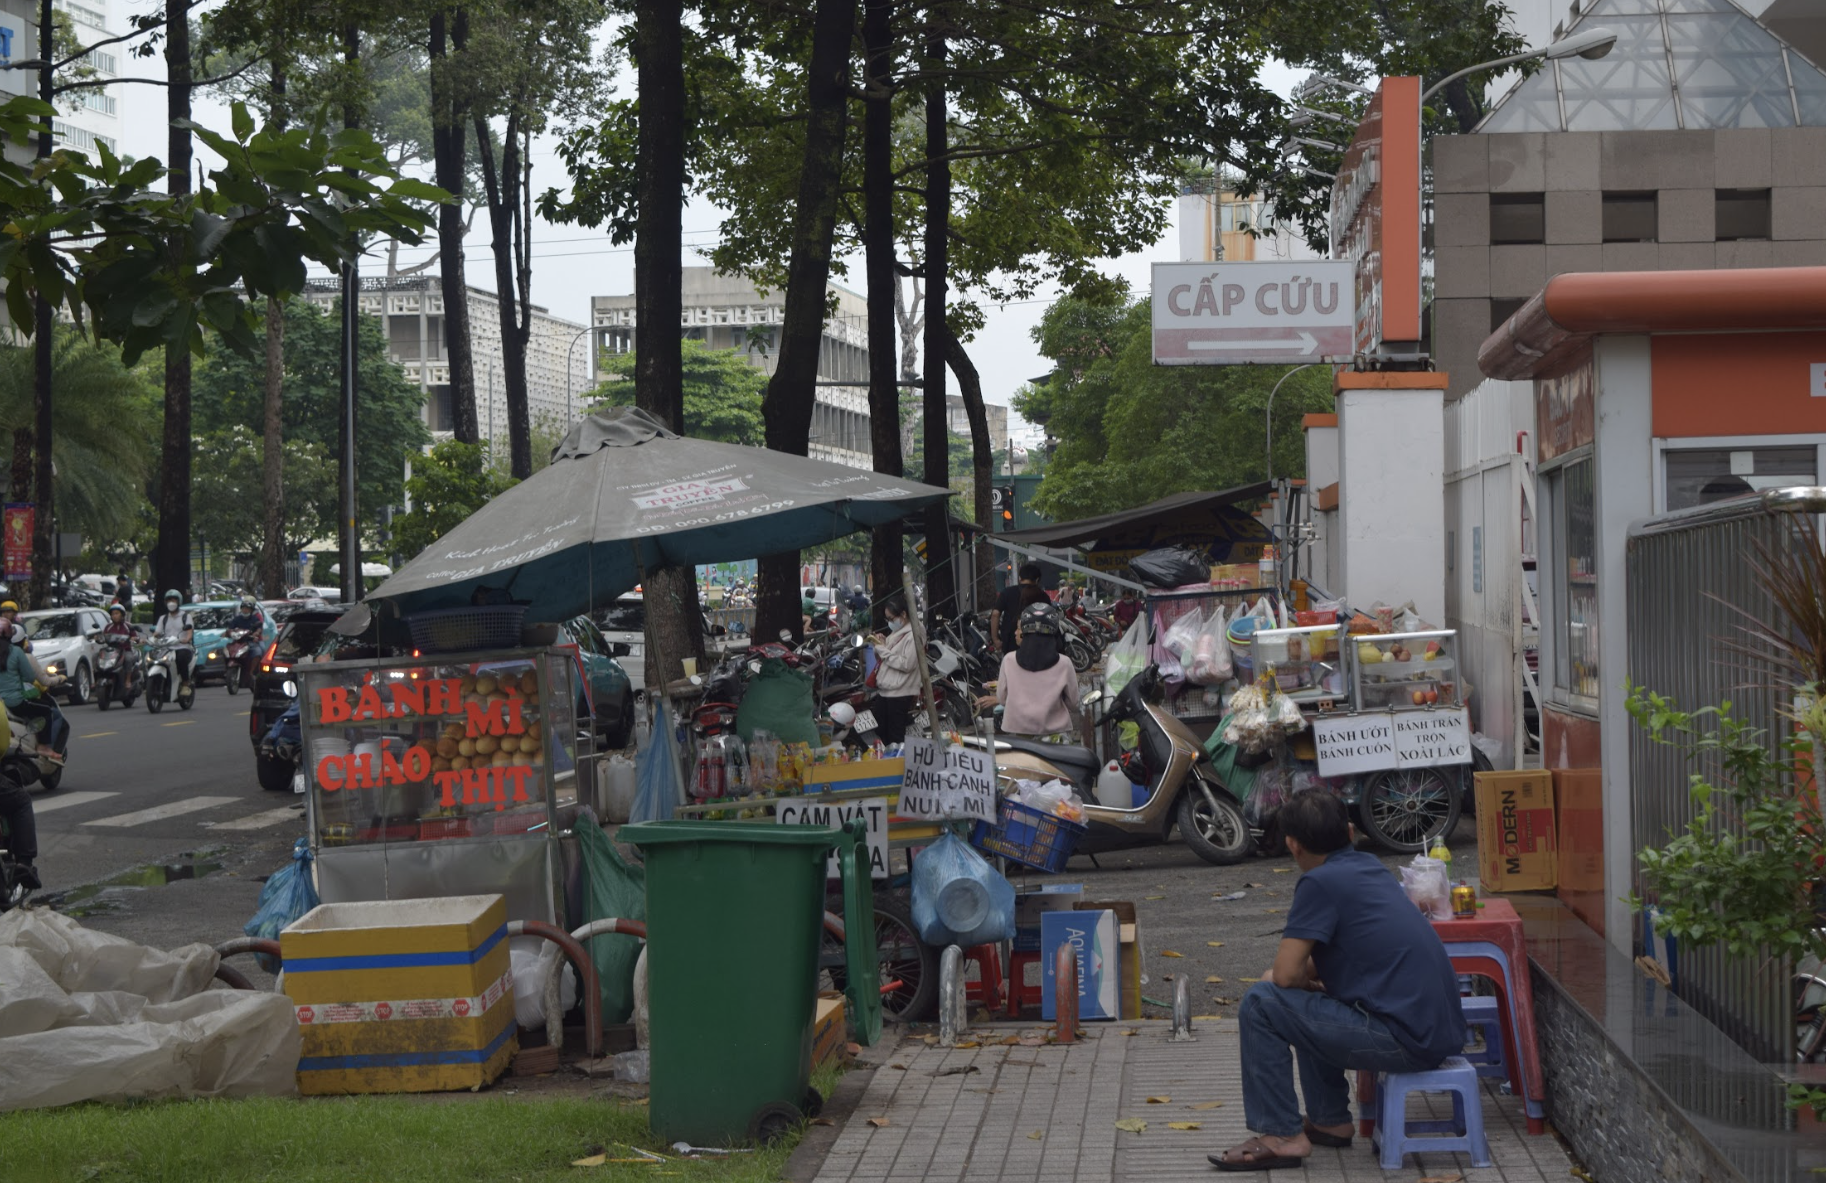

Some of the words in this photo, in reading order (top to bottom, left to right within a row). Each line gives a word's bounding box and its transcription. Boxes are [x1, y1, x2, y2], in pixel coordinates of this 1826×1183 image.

[1167, 272, 1245, 317] CẤP
[1254, 275, 1339, 315] CỨU
[645, 484, 734, 507] TRUYỀN
[662, 482, 701, 494] GIA
[675, 496, 716, 508] COFFEE
[450, 566, 486, 580] GIA
[317, 670, 464, 724] BÁNH
[464, 686, 526, 738] MÌ
[1397, 719, 1428, 731] BÁNH
[1318, 729, 1356, 744] BÁNH
[1360, 725, 1390, 740] ƯỚT
[1415, 732, 1446, 744] TRỘN
[913, 743, 934, 766] HỦ
[1320, 746, 1354, 759] BÁNH
[1357, 741, 1392, 756] CUỐN
[1399, 745, 1433, 761] XOÀI
[317, 739, 432, 791] CHÁO
[433, 764, 533, 812] THỊT
[904, 766, 941, 791] BÁNH
[947, 773, 990, 796] CANH
[904, 795, 940, 814] NUI
[963, 796, 985, 815] MÌ
[782, 807, 830, 825] CAM
[837, 800, 882, 832] VẮT
[1501, 790, 1520, 875] MODERN
[299, 1011, 313, 1019] STOP
[377, 1007, 391, 1016] STOP
[454, 1003, 468, 1012] STOP
